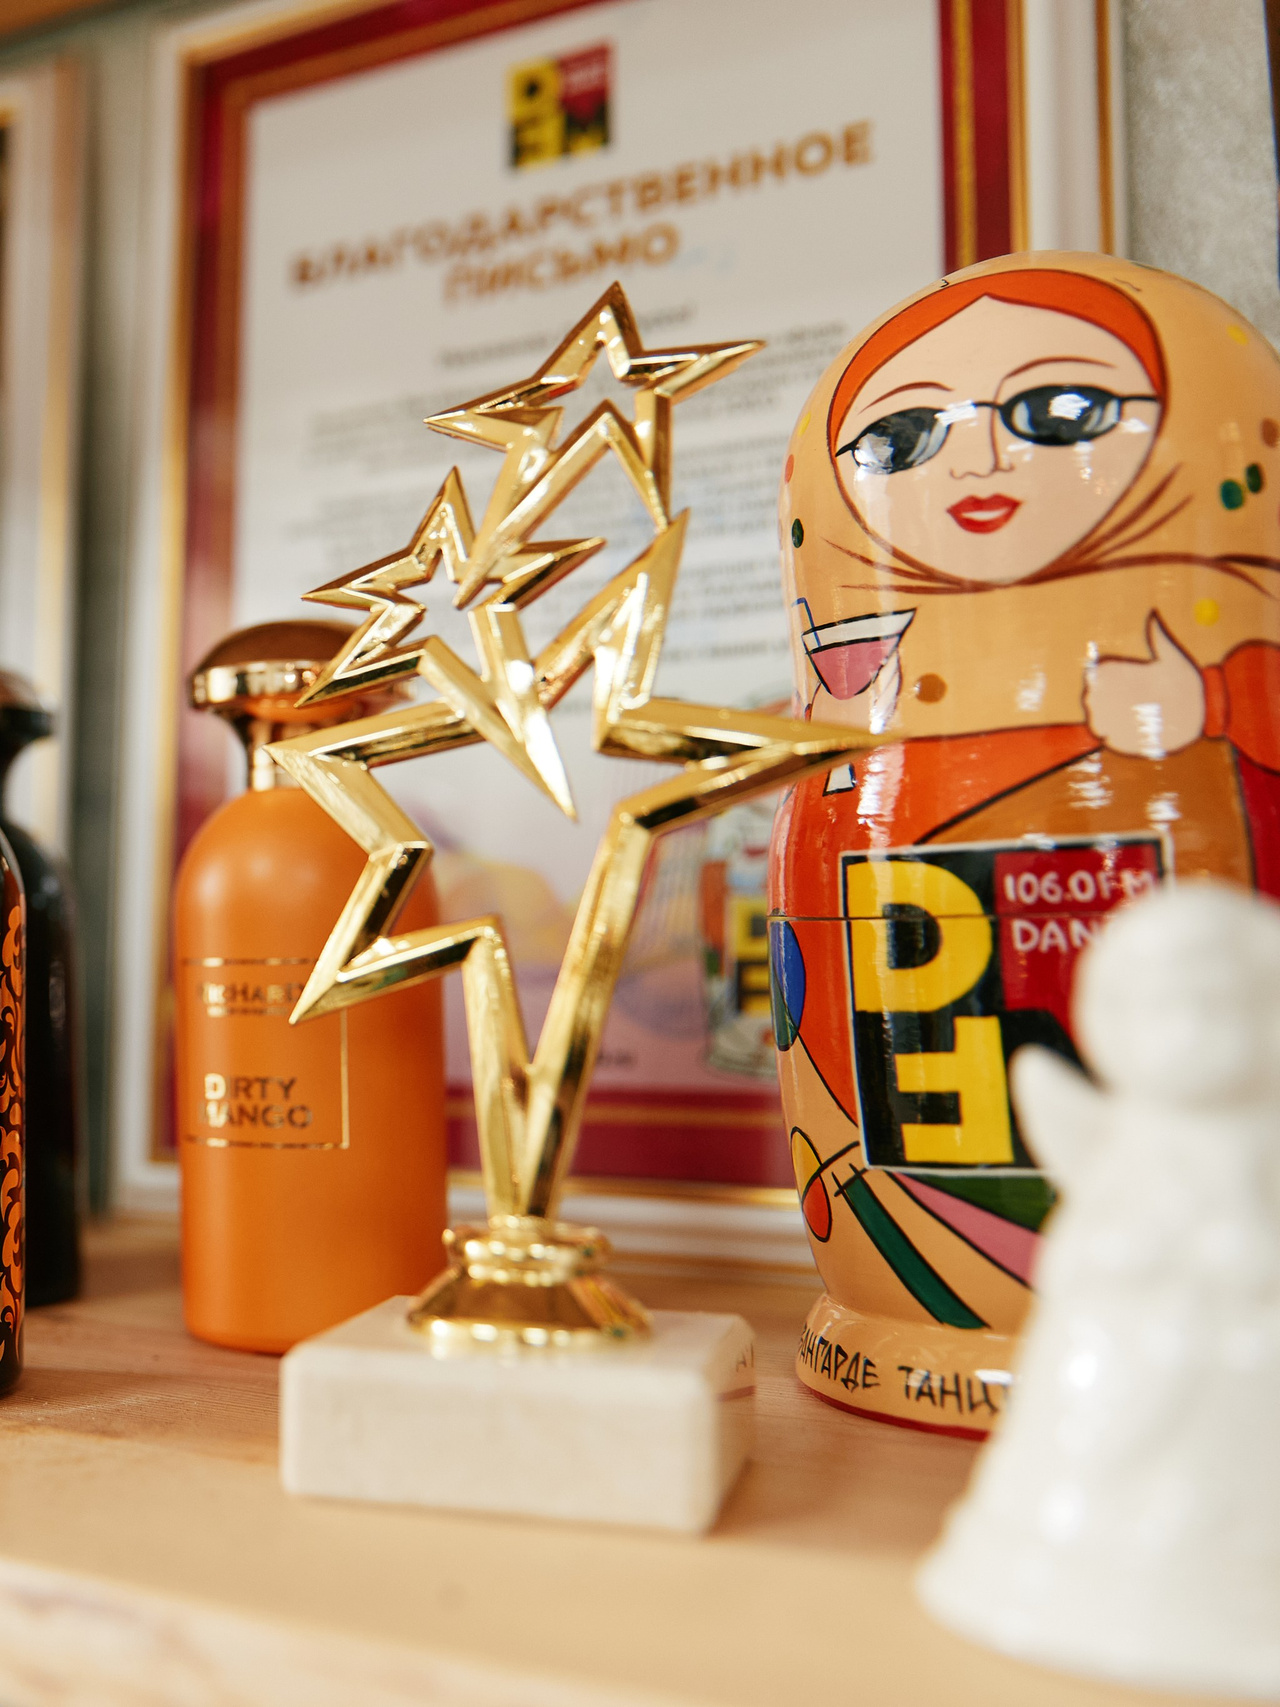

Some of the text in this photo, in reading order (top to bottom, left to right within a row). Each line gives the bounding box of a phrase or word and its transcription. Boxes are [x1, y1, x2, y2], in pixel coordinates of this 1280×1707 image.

[444, 222, 680, 303] ПИСЬМО
[1012, 918, 1107, 954] DAN
[204, 1072, 297, 1101] DIRTY
[897, 1364, 1012, 1416] ТАНЦ
